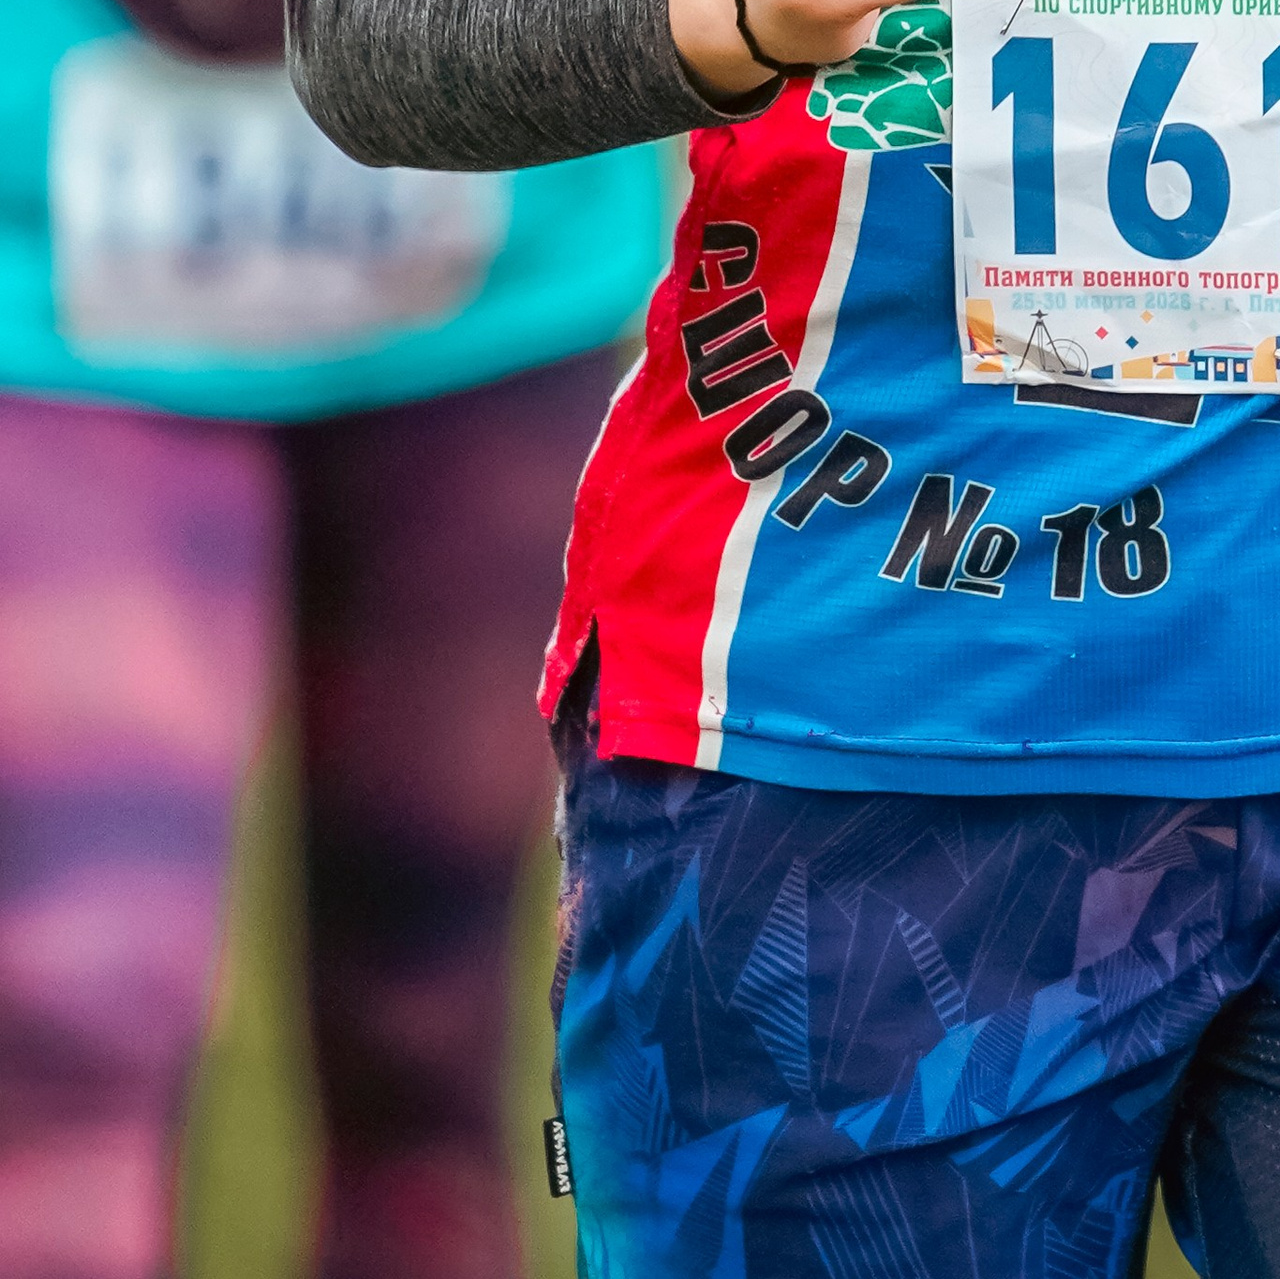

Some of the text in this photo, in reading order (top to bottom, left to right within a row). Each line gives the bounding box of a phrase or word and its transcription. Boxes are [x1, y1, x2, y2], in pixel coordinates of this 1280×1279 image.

[984, 266, 1074, 288] Памяти
[1082, 269, 1190, 289] военного
[1074, 294, 1136, 313] марта
[680, 221, 893, 531] СШОР
[1041, 484, 1171, 602] 18
